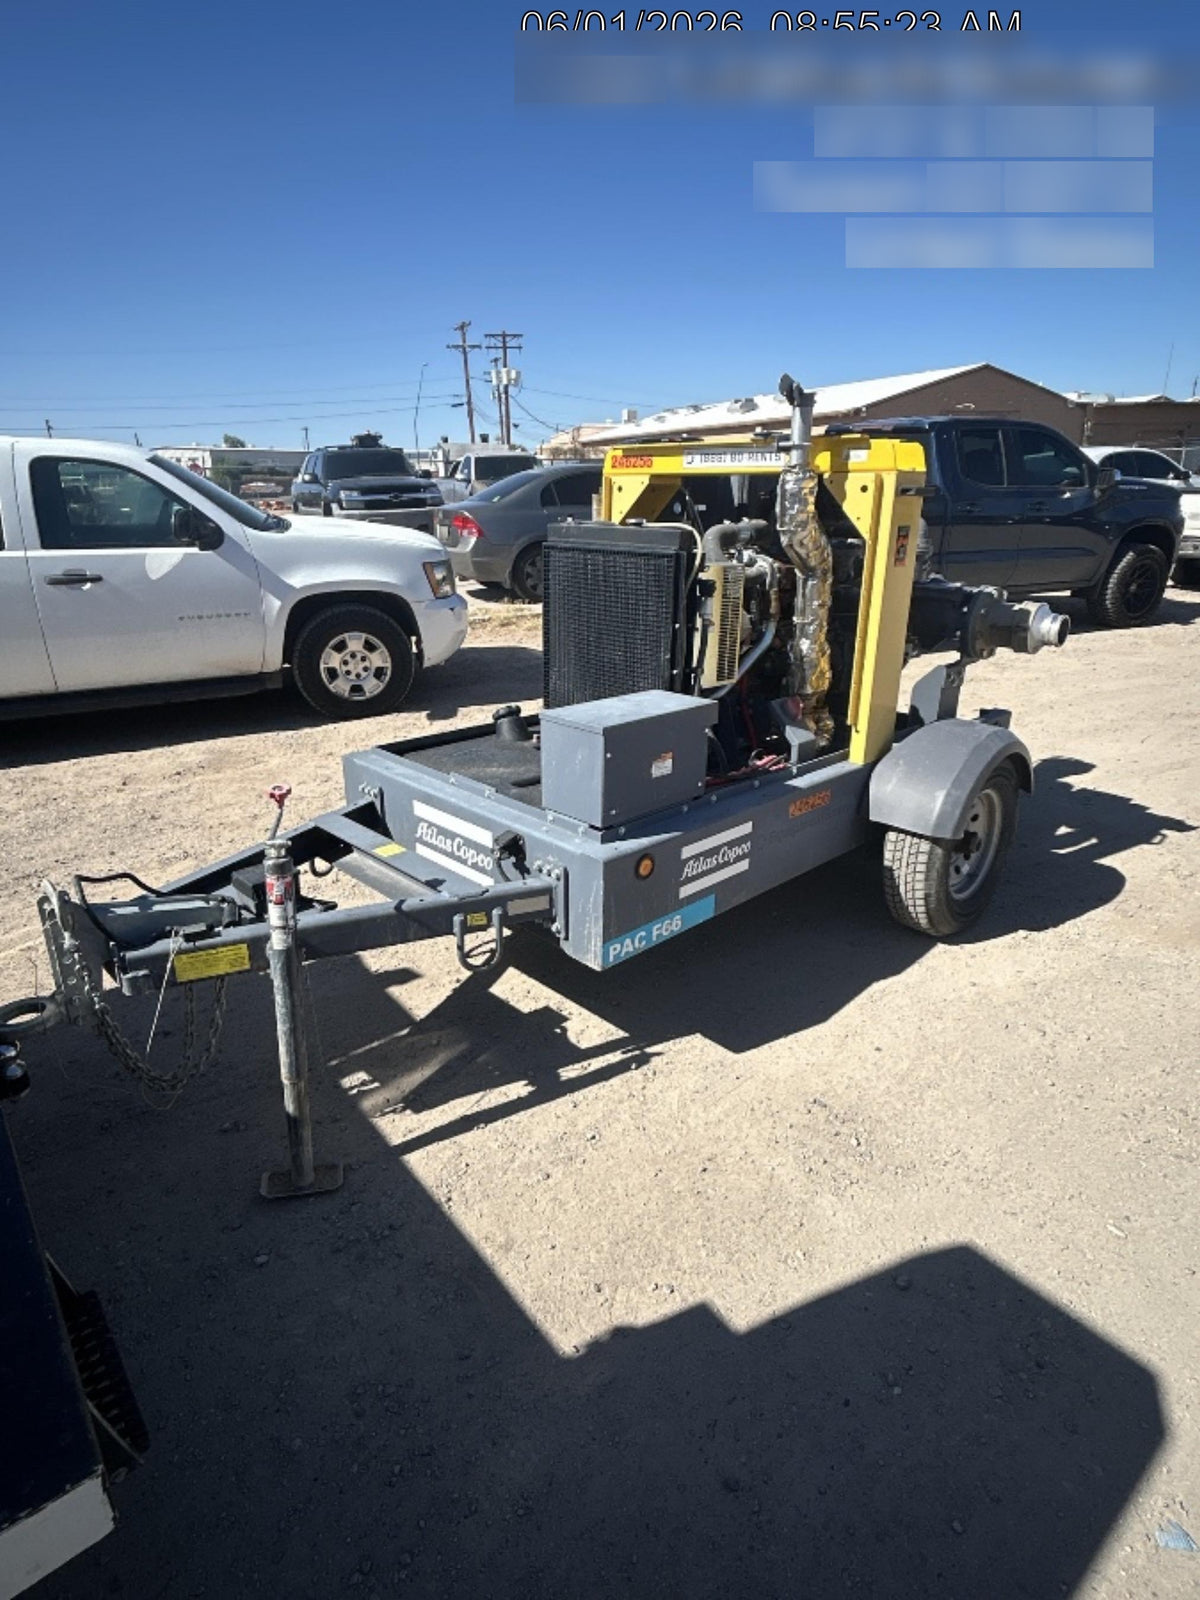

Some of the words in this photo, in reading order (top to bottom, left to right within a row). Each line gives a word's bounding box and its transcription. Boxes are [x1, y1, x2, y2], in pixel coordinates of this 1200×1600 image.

[415, 820, 452, 853] Atlas
[452, 836, 493, 872] Copco
[680, 857, 717, 881] Atlas
[717, 841, 751, 864] Copco
[609, 931, 647, 963] PAC
[652, 914, 683, 942] F66
